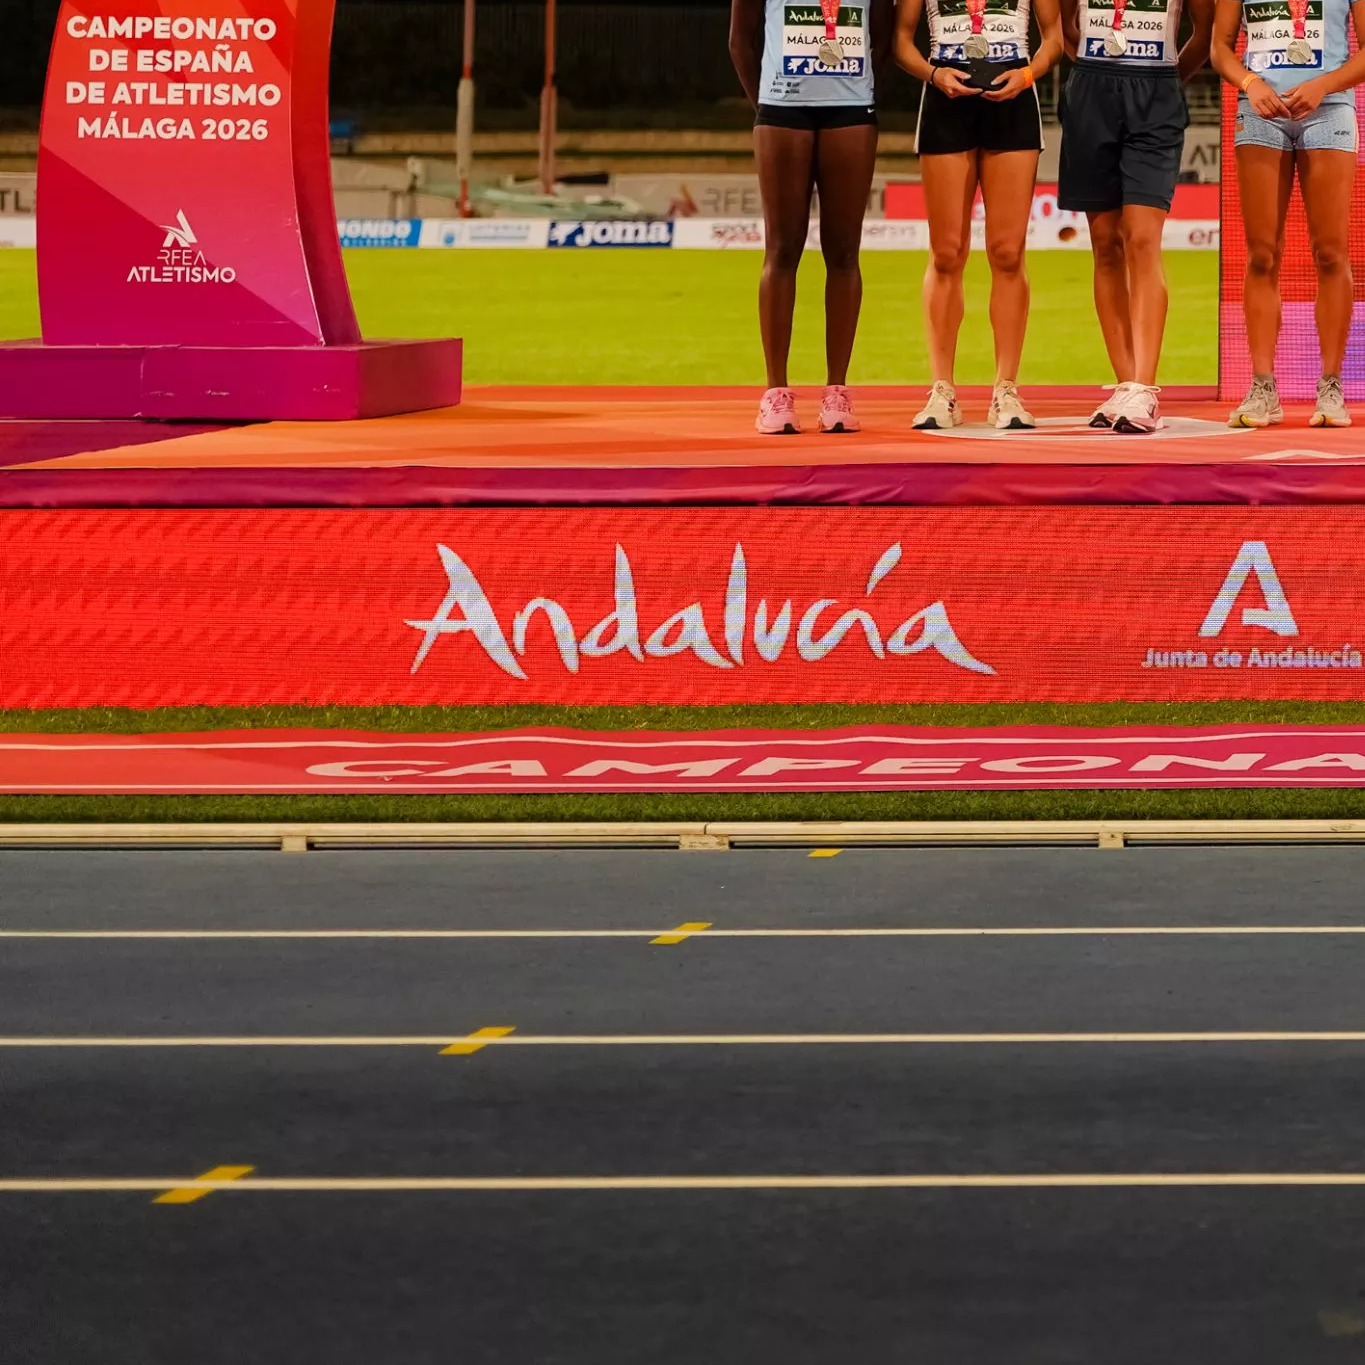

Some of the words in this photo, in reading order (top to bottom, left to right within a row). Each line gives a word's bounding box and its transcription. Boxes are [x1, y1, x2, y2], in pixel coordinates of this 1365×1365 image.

[67, 16, 276, 41] CAMPEONATO
[943, 22, 987, 34] MÁLAA
[991, 23, 1014, 33] 2026
[1089, 16, 1134, 29] MÁLGA
[1137, 21, 1163, 31] 2026
[787, 33, 827, 45] MÁLAG
[839, 36, 862, 46] 2026
[89, 49, 129, 72] DE
[136, 43, 254, 73] ESPAÑA
[66, 81, 106, 105] DE
[112, 82, 281, 106] ATLETISMO
[78, 111, 196, 140] MÁLAGA
[201, 118, 268, 141] 2026
[702, 188, 758, 212] RFE
[127, 266, 236, 283] ATLETISMO
[405, 541, 997, 680] Andalucía
[1142, 648, 1208, 668] Junta
[1212, 647, 1243, 668] de
[1247, 643, 1363, 668] Andalucía
